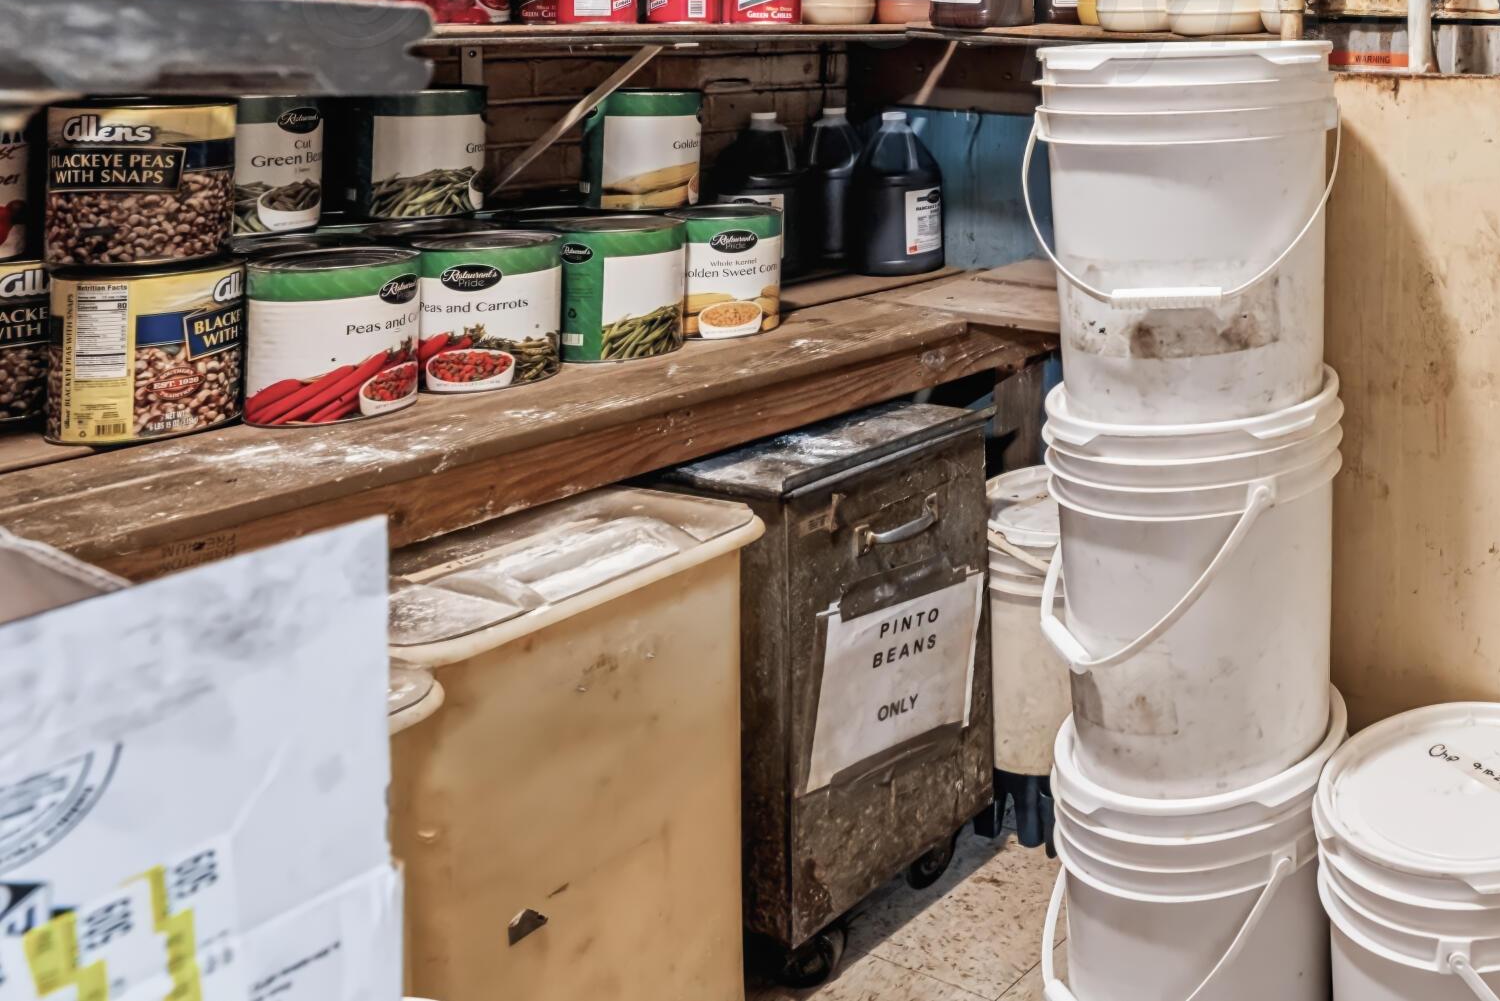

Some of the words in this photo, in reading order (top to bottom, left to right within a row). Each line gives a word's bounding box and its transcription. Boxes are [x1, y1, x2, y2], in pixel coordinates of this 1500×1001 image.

[746, 10, 769, 19] GREEN
[1354, 54, 1391, 64] WARNING
[295, 139, 311, 150] Cut
[51, 153, 124, 170] BLACKEYE
[128, 153, 175, 168] PEAS
[251, 153, 303, 168] Green
[55, 170, 97, 185] WITH
[101, 168, 164, 184] SNAPS
[710, 259, 731, 267] Whole
[734, 258, 757, 267] Kernel
[687, 268, 719, 280] olden
[722, 265, 755, 278] Sweet
[758, 263, 777, 275] Corn
[458, 278, 485, 288] Pride
[65, 294, 74, 319] SNAPS
[117, 302, 128, 310] 80
[419, 301, 442, 313] Peas
[446, 301, 471, 313] and
[475, 297, 529, 313] Carrots
[65, 321, 73, 344] WITH
[346, 320, 381, 336] Peas
[385, 313, 406, 330] and
[202, 326, 239, 348] WITH
[64, 366, 72, 407] BLACKEYE
[154, 420, 165, 430] LBS
[879, 607, 939, 639] PINTO
[872, 634, 937, 669] BEANS
[877, 693, 918, 722] ONLY
